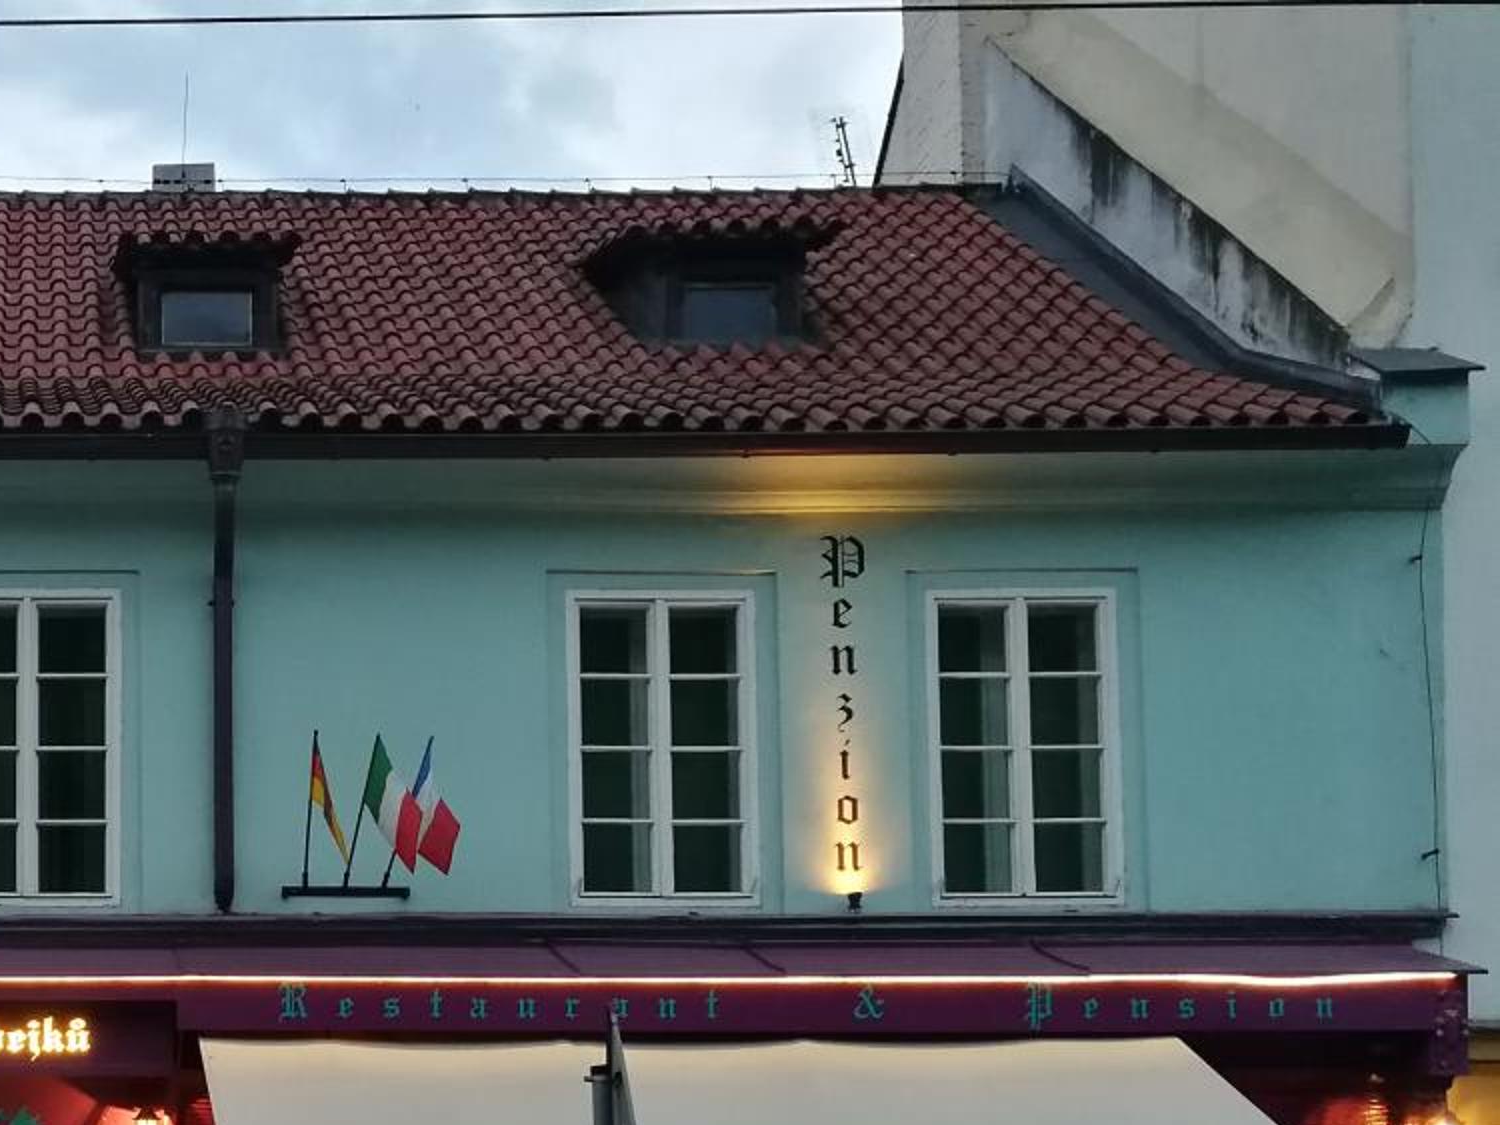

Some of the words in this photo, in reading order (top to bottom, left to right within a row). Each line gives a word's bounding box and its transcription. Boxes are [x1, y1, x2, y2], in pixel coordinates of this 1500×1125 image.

[820, 535, 865, 871] Penzion
[278, 982, 719, 1021] Restaurant
[854, 983, 884, 1018] &
[1026, 982, 1333, 1030] Pension
